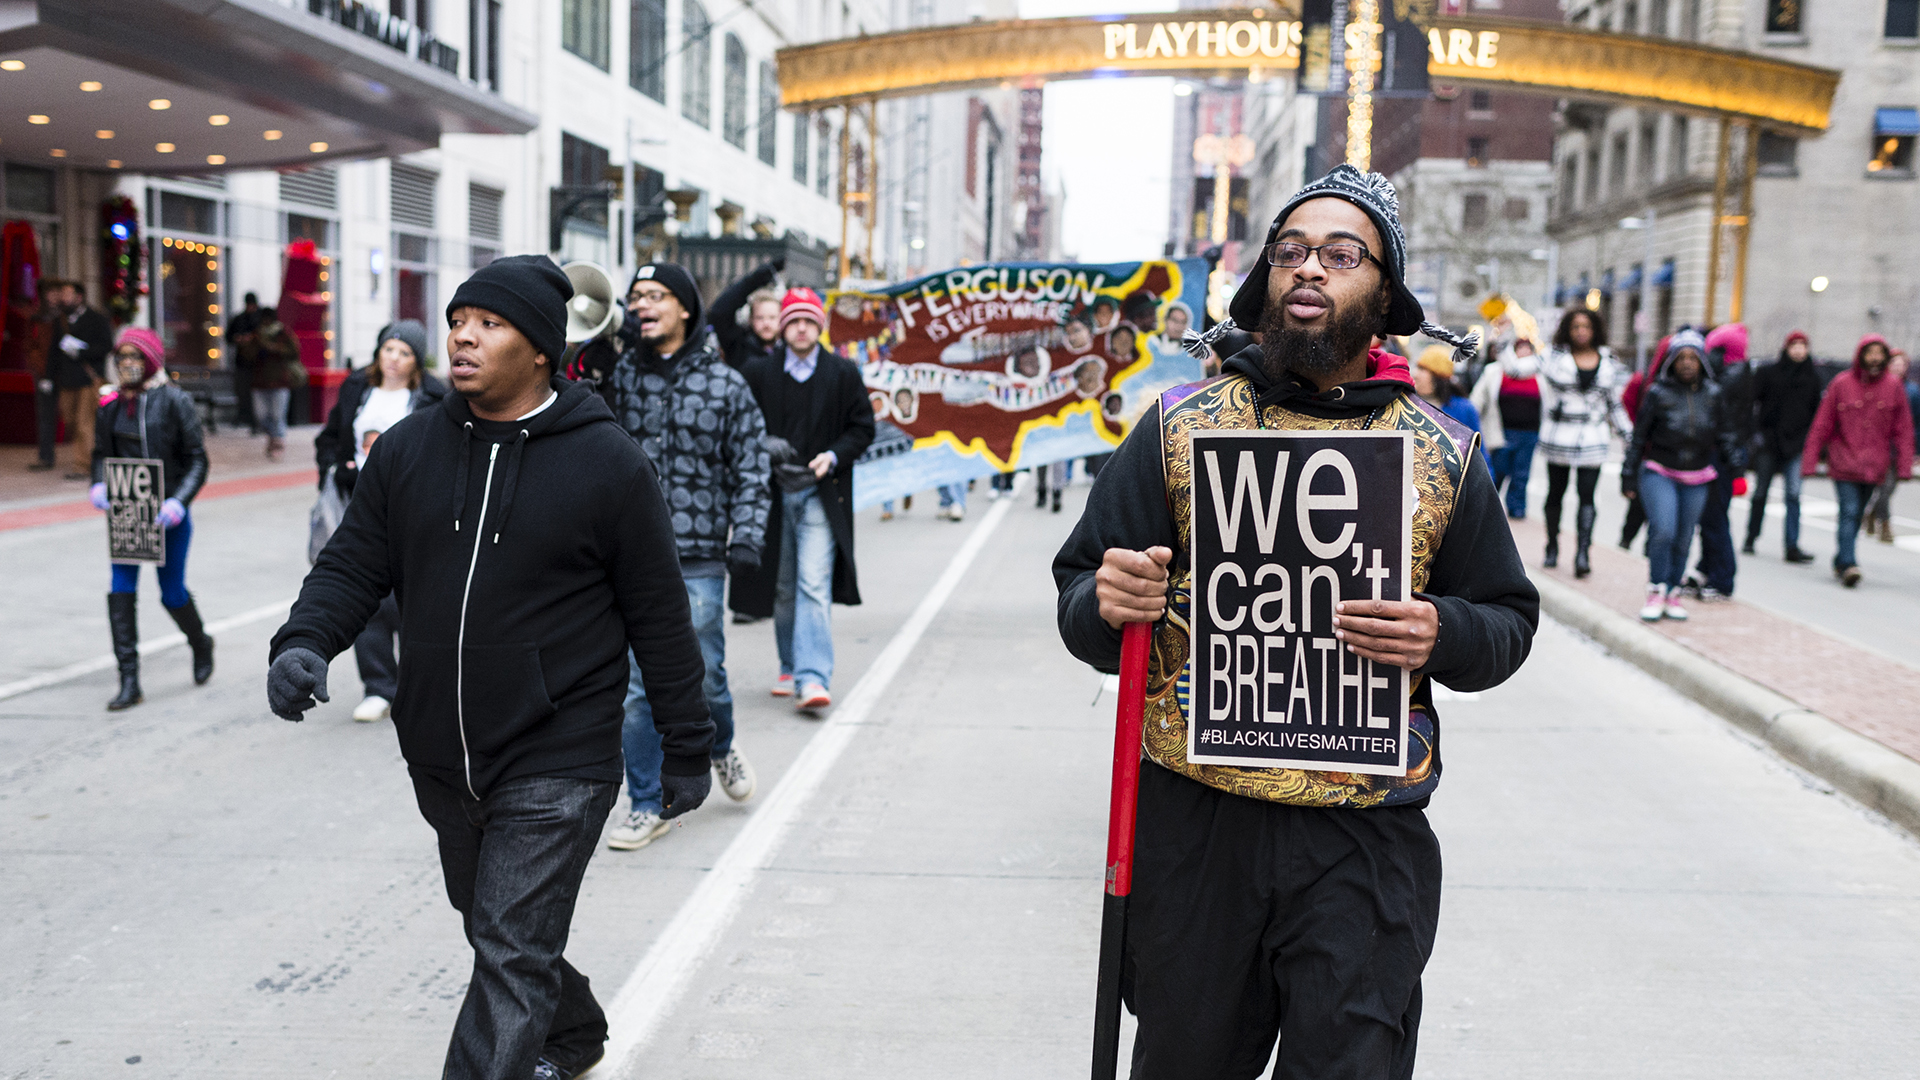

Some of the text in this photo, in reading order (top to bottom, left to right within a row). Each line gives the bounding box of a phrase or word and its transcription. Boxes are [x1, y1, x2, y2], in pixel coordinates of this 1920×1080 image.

[1104, 20, 1303, 60] PLAYHOUS
[896, 267, 1105, 328] FERGUSON
[925, 301, 1073, 343] IS EVERYWHERE
[1207, 543, 1390, 633] can't
[1209, 634, 1390, 729] BREATHE
[1200, 729, 1396, 754] #BLACKLIVESMATTER
